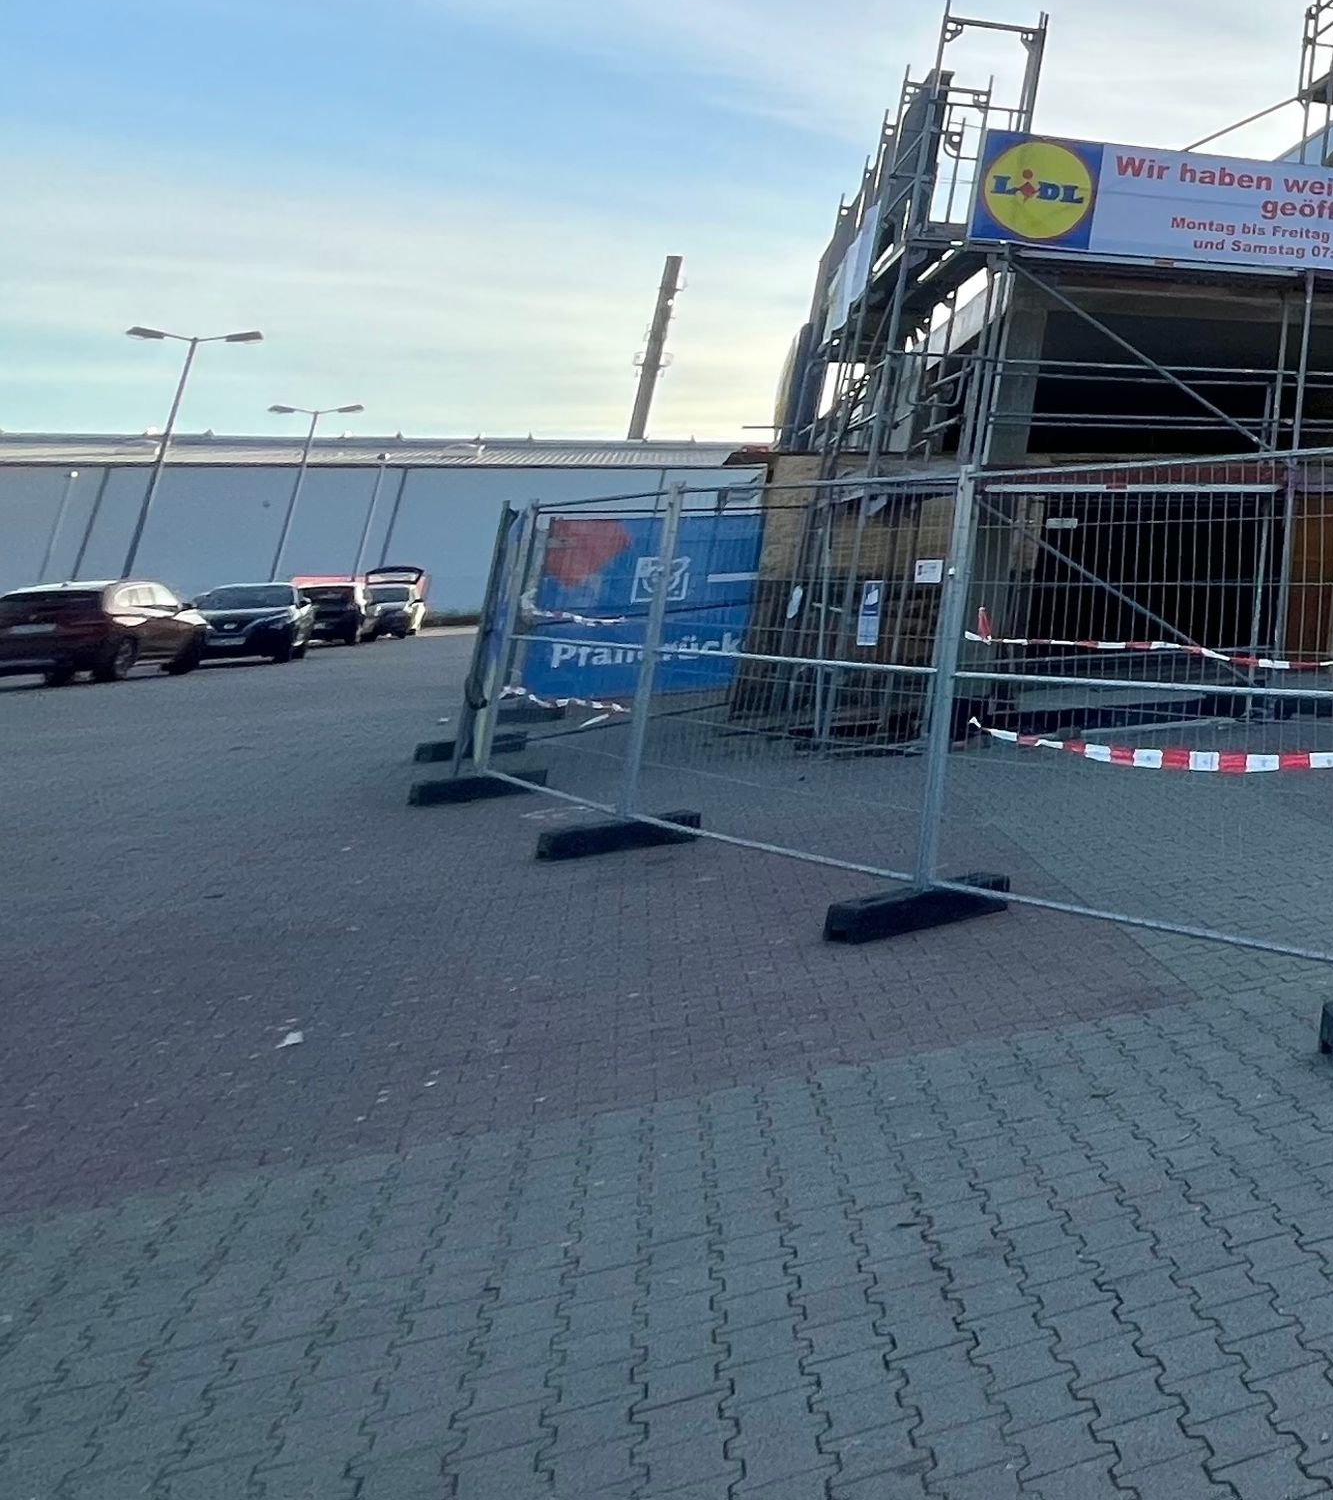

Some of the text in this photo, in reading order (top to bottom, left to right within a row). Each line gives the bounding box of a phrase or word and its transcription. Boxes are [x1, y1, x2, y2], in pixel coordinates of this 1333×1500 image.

[1116, 155, 1170, 181] Wir
[1179, 162, 1273, 191] haben
[1170, 216, 1236, 236] Montag
[1241, 223, 1266, 236] bis
[1272, 225, 1331, 244] Freitag
[1193, 238, 1225, 251] und
[1231, 239, 1306, 259] Samstag
[551, 631, 744, 669] Pfanrück
